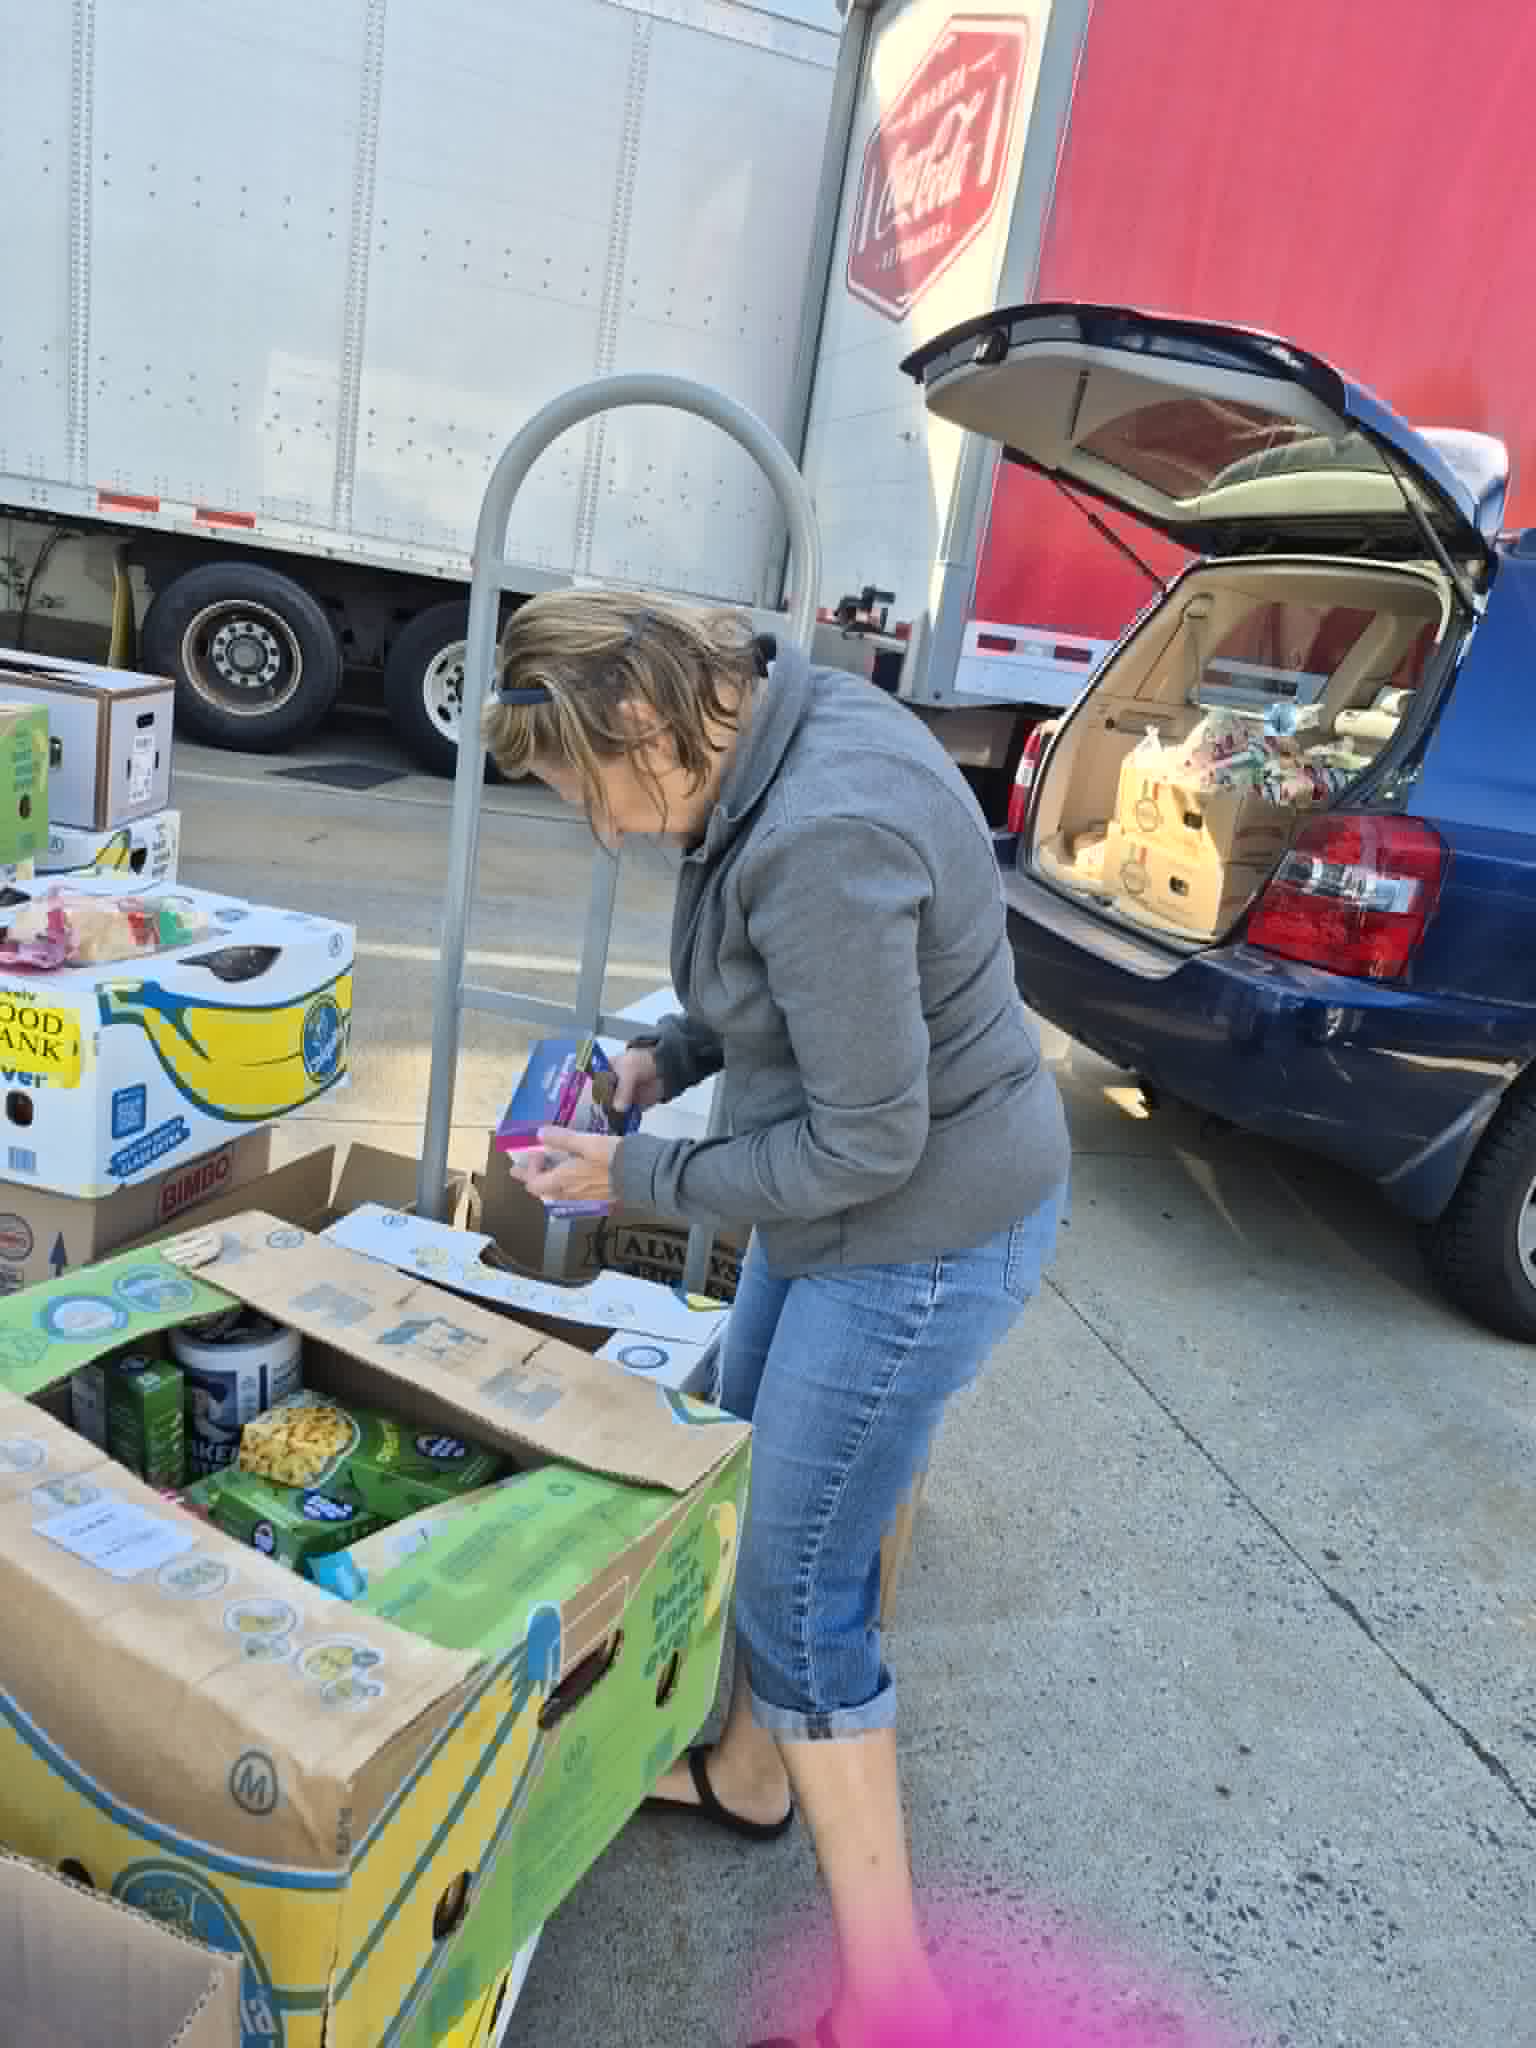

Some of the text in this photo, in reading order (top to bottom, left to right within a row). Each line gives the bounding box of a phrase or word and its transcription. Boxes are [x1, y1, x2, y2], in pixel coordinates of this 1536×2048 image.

[0, 1002, 64, 1036] OOD
[0, 1027, 64, 1064] ANK
[0, 1064, 48, 1089] ver
[625, 1236, 742, 1283] ALWYS
